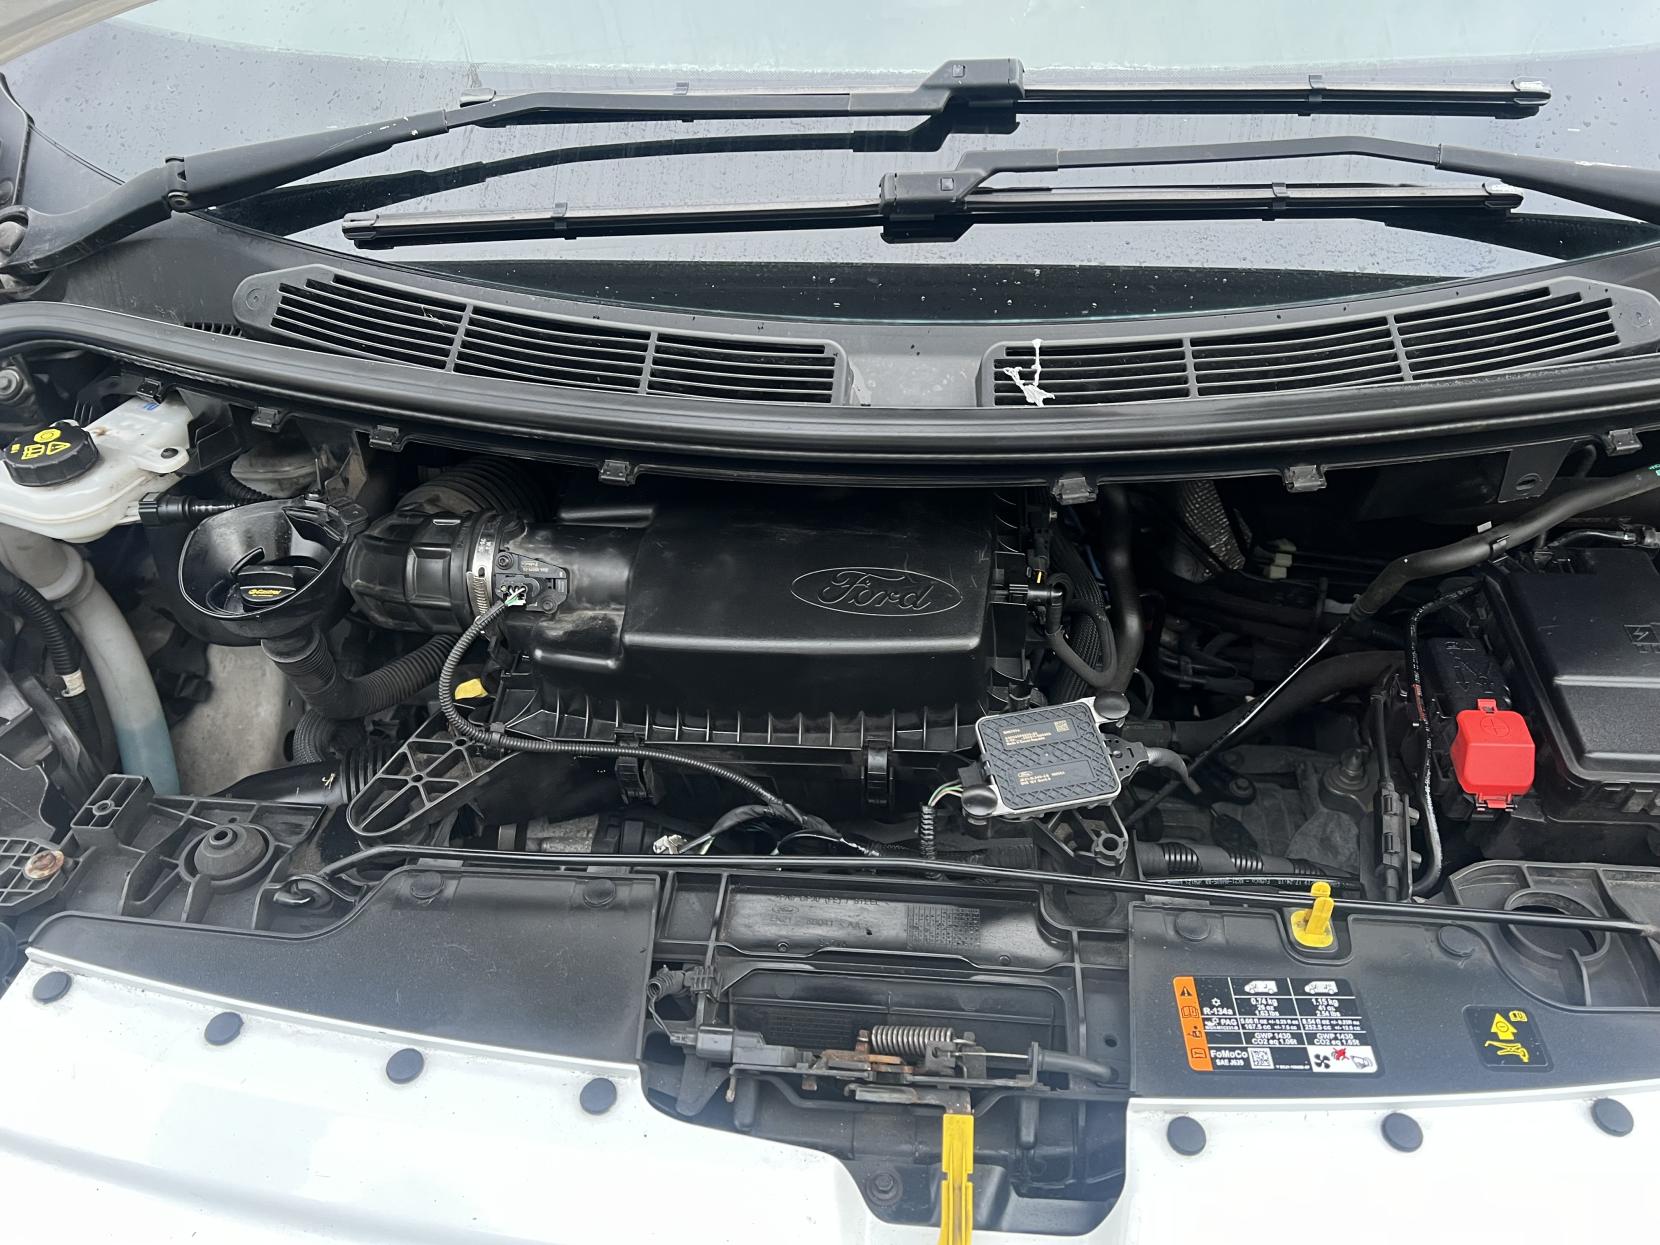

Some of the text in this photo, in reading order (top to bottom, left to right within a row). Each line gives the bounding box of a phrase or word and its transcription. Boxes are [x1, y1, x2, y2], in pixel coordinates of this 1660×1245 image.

[813, 570, 935, 610] Ford
[1268, 998, 1278, 1006] kg
[1328, 998, 1339, 1007] kg
[1202, 1007, 1234, 1015] R-134a
[1210, 1049, 1248, 1058] FoMoCo
